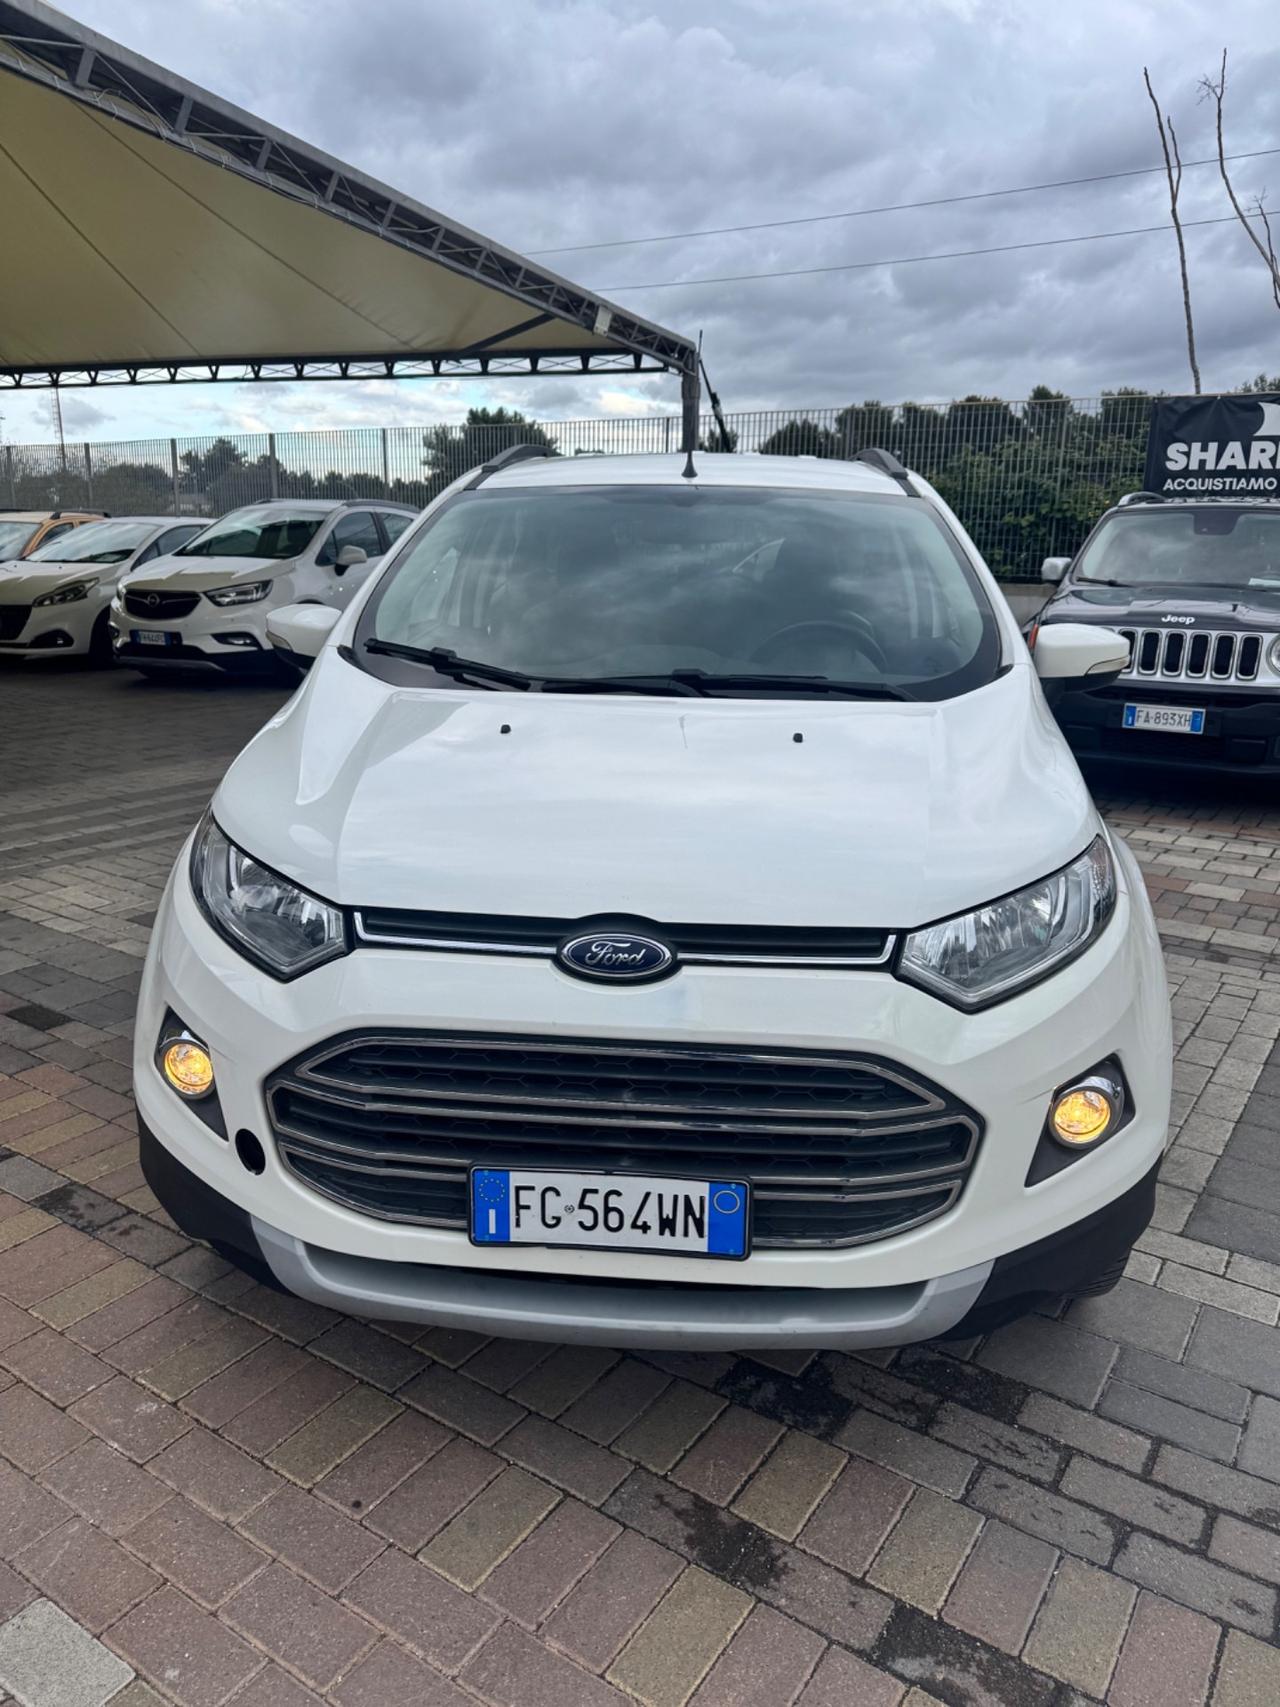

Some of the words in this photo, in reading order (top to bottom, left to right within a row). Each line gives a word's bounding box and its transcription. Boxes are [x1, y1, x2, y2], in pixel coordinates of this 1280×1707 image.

[1165, 441, 1280, 471] SHAR
[1163, 477, 1277, 491] ACQUISTIAMO
[1161, 614, 1196, 625] Jeep
[585, 940, 646, 966] Ford
